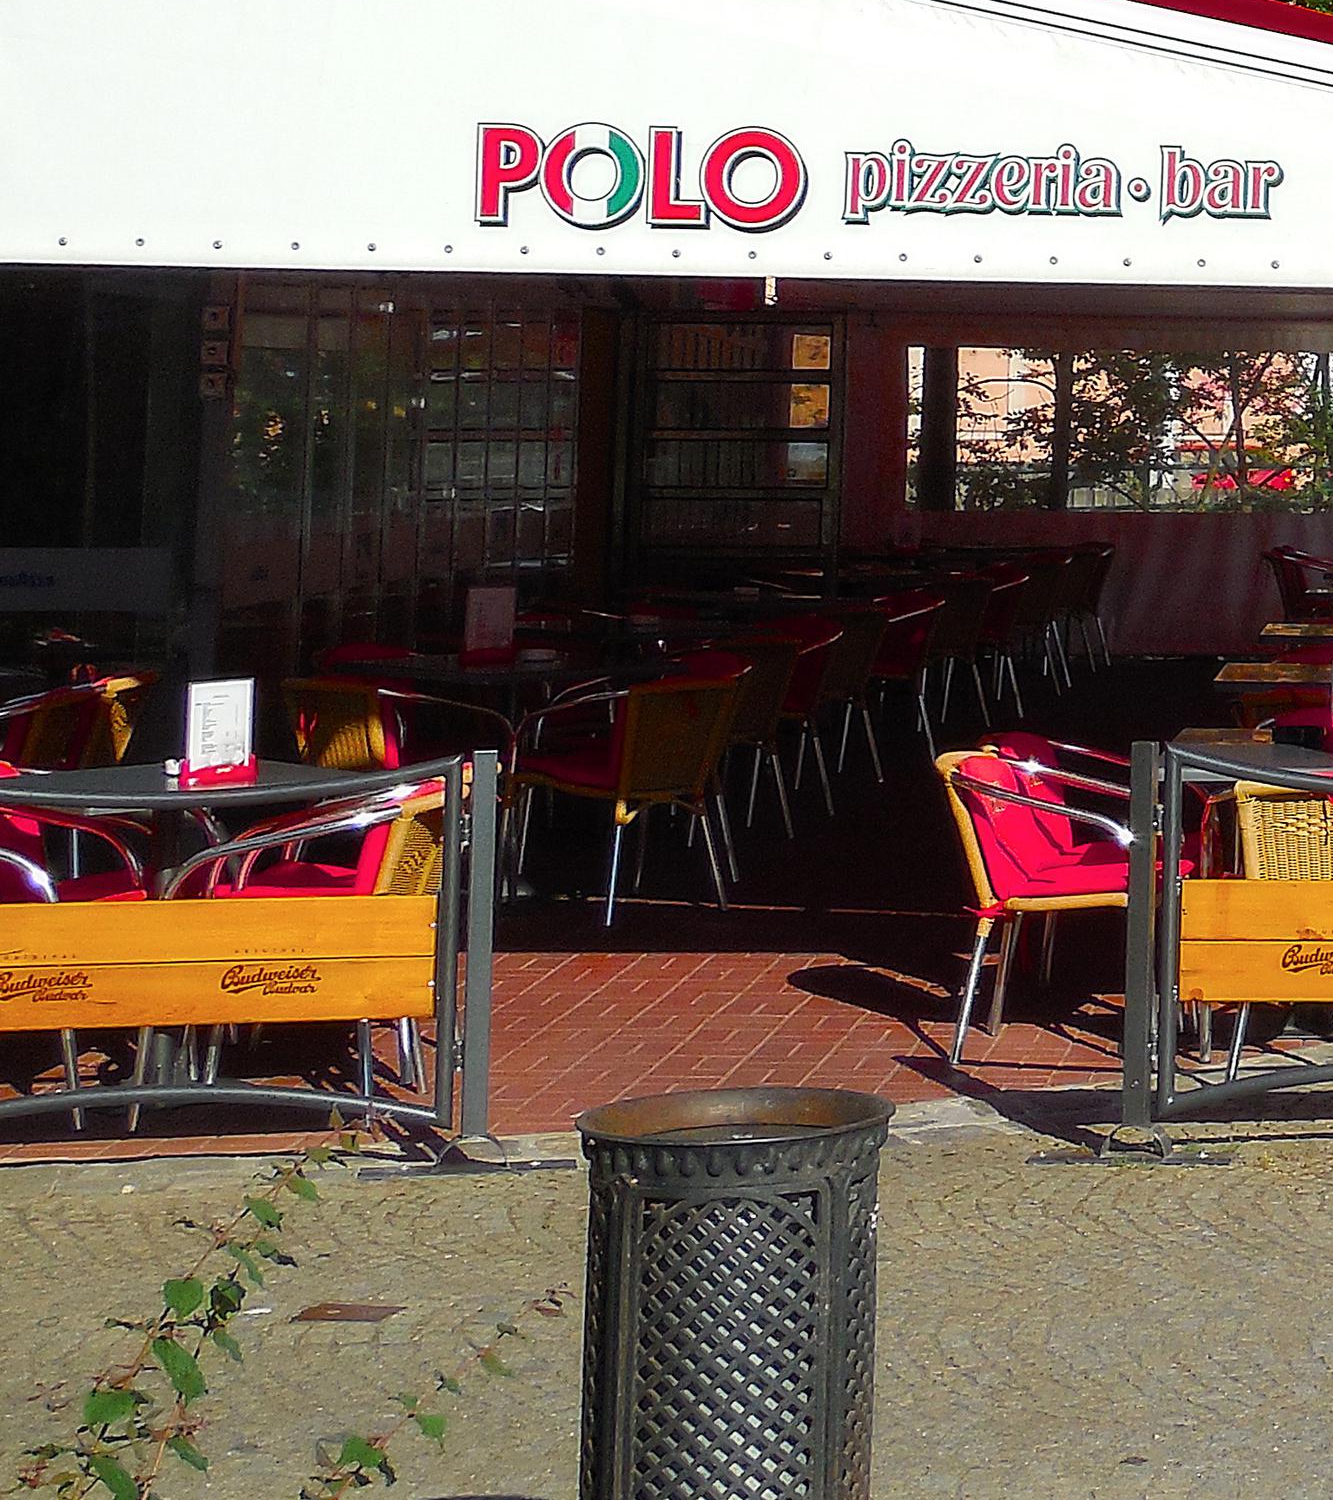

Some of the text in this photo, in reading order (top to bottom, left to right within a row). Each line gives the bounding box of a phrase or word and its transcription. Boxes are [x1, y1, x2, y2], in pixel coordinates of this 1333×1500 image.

[474, 122, 808, 232] POLO
[841, 138, 1284, 225] pizzeria bar
[221, 964, 322, 994] Budweiser
